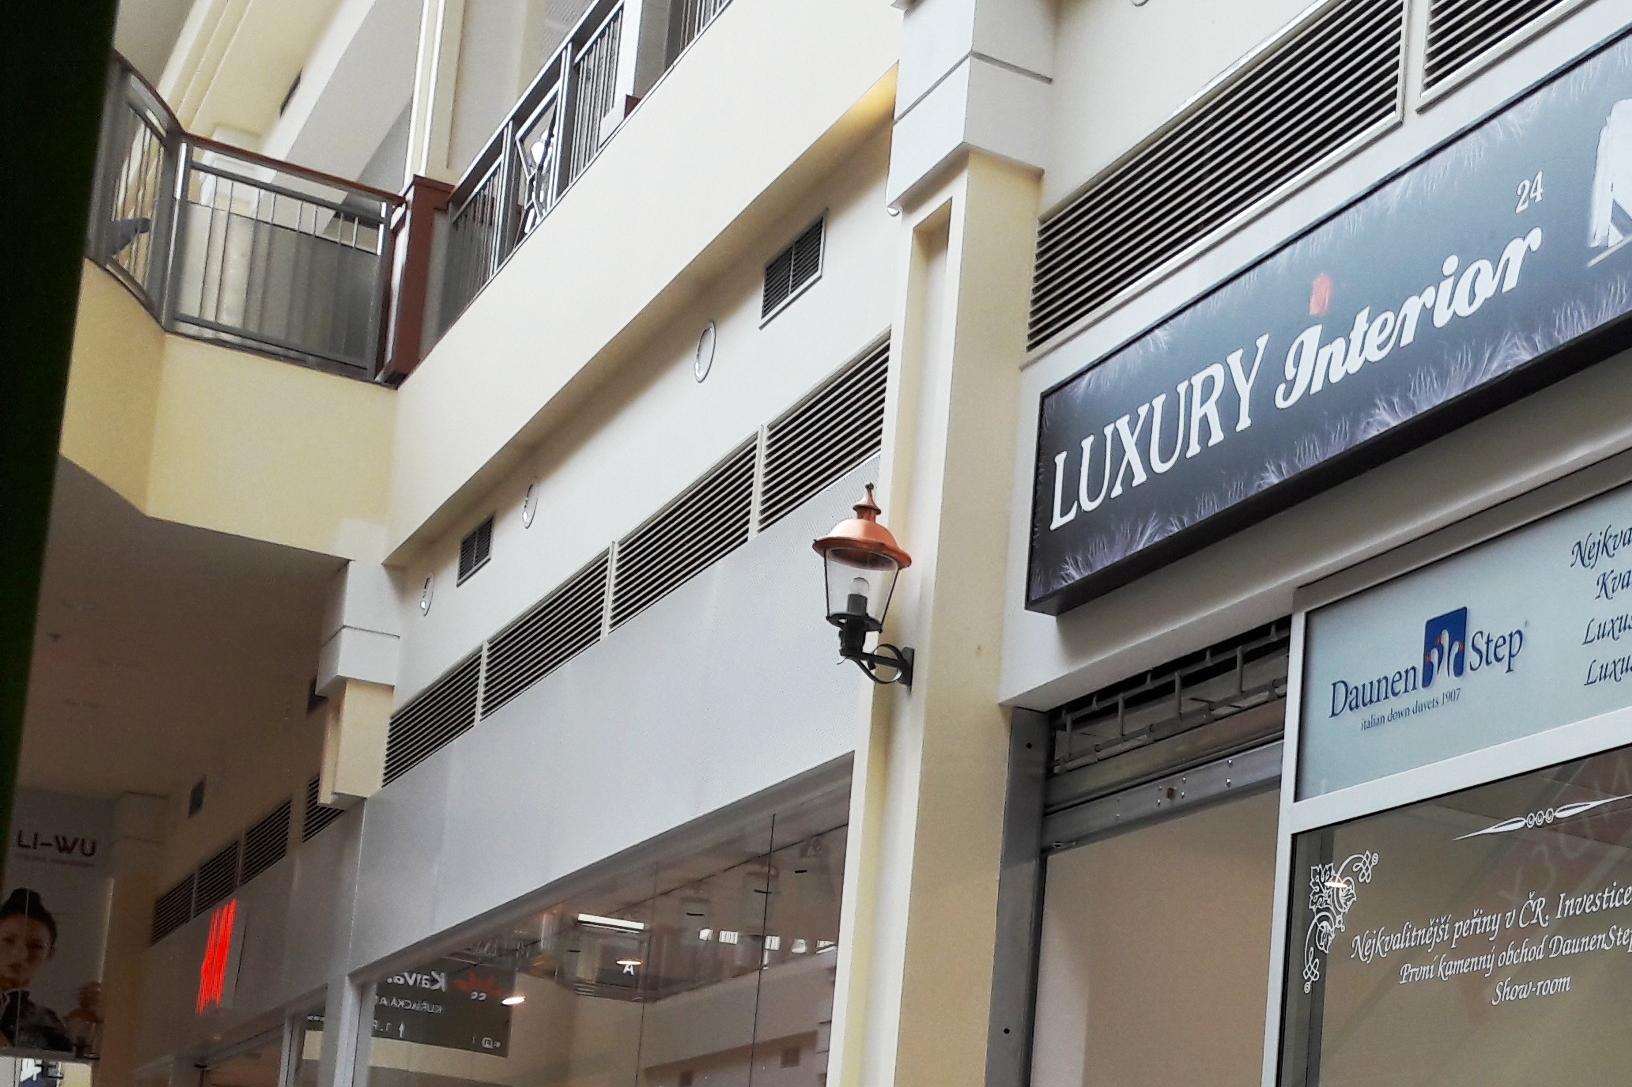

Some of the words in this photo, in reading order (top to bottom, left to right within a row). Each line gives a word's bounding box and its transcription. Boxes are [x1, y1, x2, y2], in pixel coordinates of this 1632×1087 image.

[1515, 170, 1543, 215] 24
[1050, 333, 1269, 531] LUXURY
[1274, 227, 1542, 410] Interior
[1329, 665, 1417, 719] Daunen
[1469, 628, 1524, 674] Step
[1360, 711, 1385, 731] italian
[1387, 706, 1410, 722] down
[1412, 697, 1439, 716] duvets
[1441, 687, 1461, 705] 1907
[1351, 914, 1452, 964] Nejkvalitnější
[1451, 908, 1501, 949] peřiny
[1505, 909, 1516, 929] v
[1519, 891, 1549, 928] ČR.
[1556, 881, 1632, 919] Investice
[1400, 954, 1438, 984] První
[1437, 945, 1496, 981] kamenný
[1498, 934, 1549, 968] obchod
[1491, 975, 1571, 1006] Show-room
